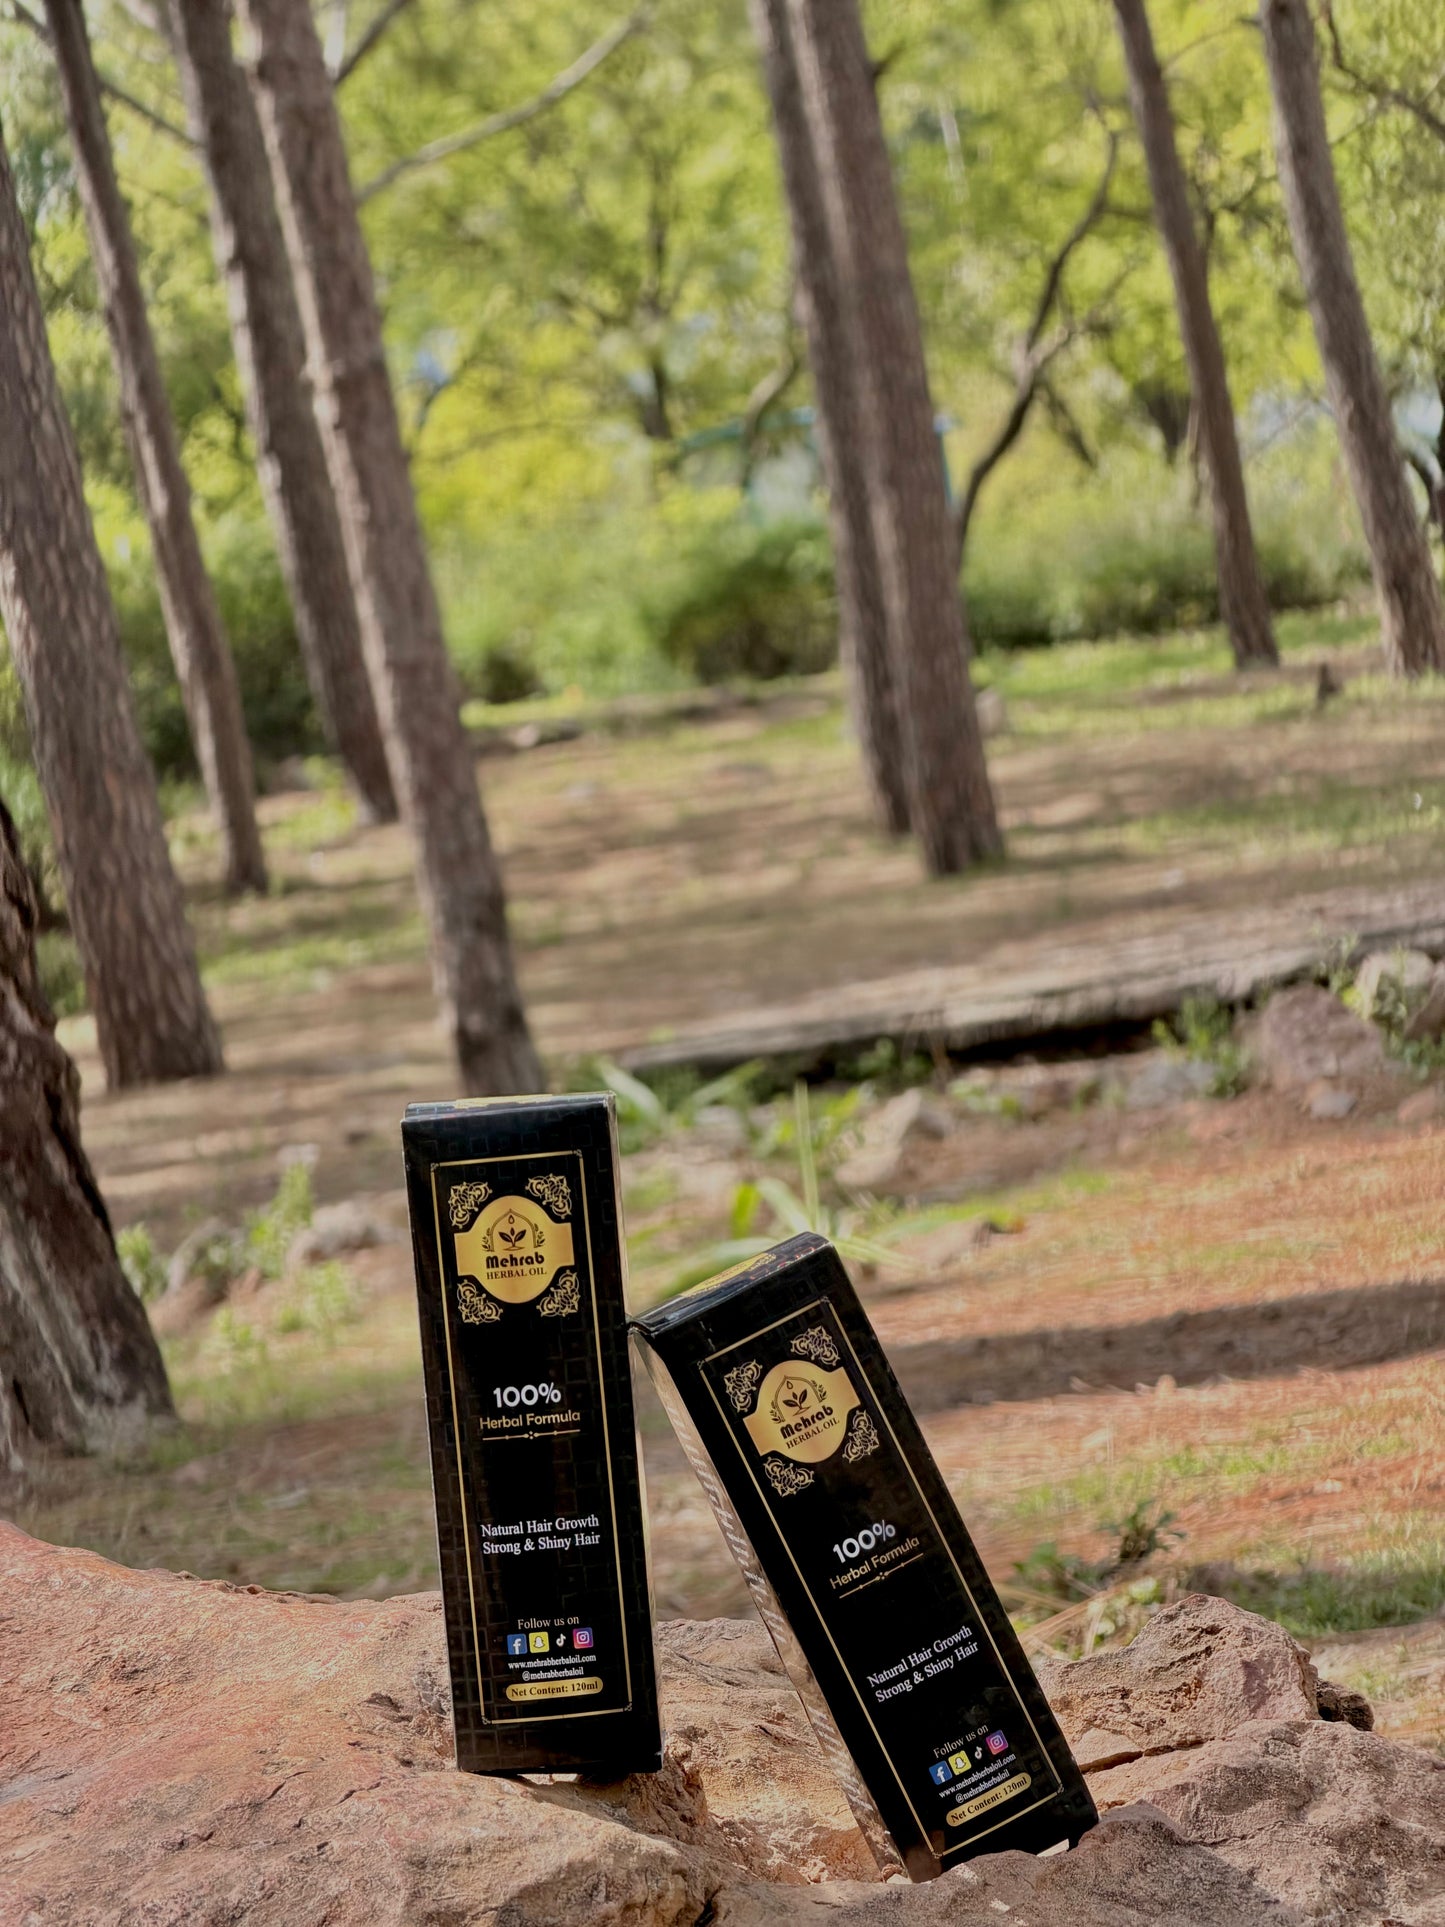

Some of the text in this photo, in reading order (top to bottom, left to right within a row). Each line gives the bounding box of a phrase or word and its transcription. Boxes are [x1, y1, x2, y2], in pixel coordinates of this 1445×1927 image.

[486, 1252, 545, 1269] Mehrab
[486, 1267, 547, 1280] HERBAL OIL
[493, 1382, 561, 1408] 100%
[480, 1409, 580, 1429] Herbal Formula
[780, 1405, 834, 1439] Mehrab
[786, 1417, 840, 1449] HERBAL OIL
[480, 1514, 599, 1537] Natural Hair Growth
[483, 1532, 600, 1555] Strong & Shiny Hair
[833, 1520, 896, 1563] 100%
[829, 1537, 920, 1589] Herbal Formula
[517, 1616, 580, 1630] Follow us on
[866, 1625, 973, 1687] Natural Hair Growth
[875, 1641, 979, 1702] Strong & Shiny Hair
[511, 1681, 598, 1697] Net Content: 120ml
[933, 1724, 989, 1758] Follow us on
[950, 1776, 1027, 1823] Net Content: 120ml
